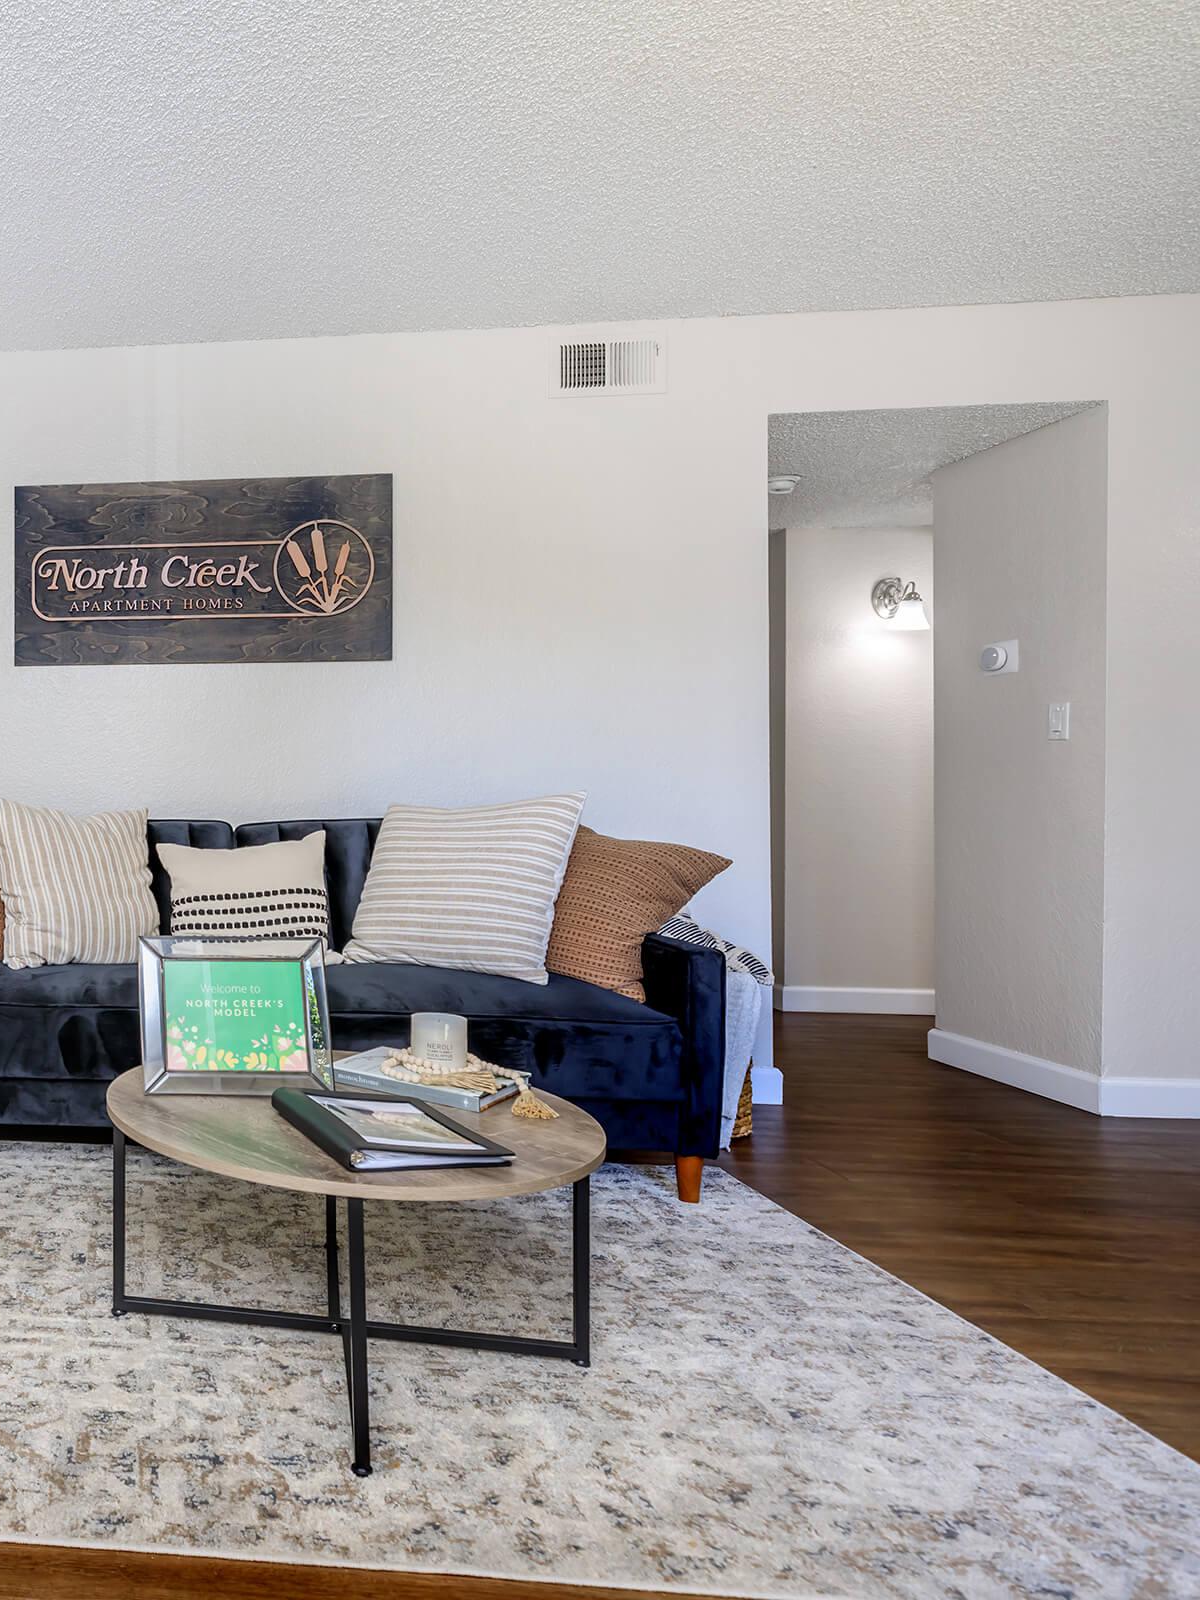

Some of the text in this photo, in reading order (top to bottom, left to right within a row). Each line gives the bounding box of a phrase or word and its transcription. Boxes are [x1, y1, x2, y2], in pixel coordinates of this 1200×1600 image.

[38, 555, 272, 593] North Creek
[69, 598, 244, 612] APARTMENT HOMES
[200, 984, 261, 994] Welcome to
[185, 999, 284, 1008] NORTH CREEK'S
[214, 1008, 257, 1017] MODEL
[426, 1042, 453, 1050] NEROLI
